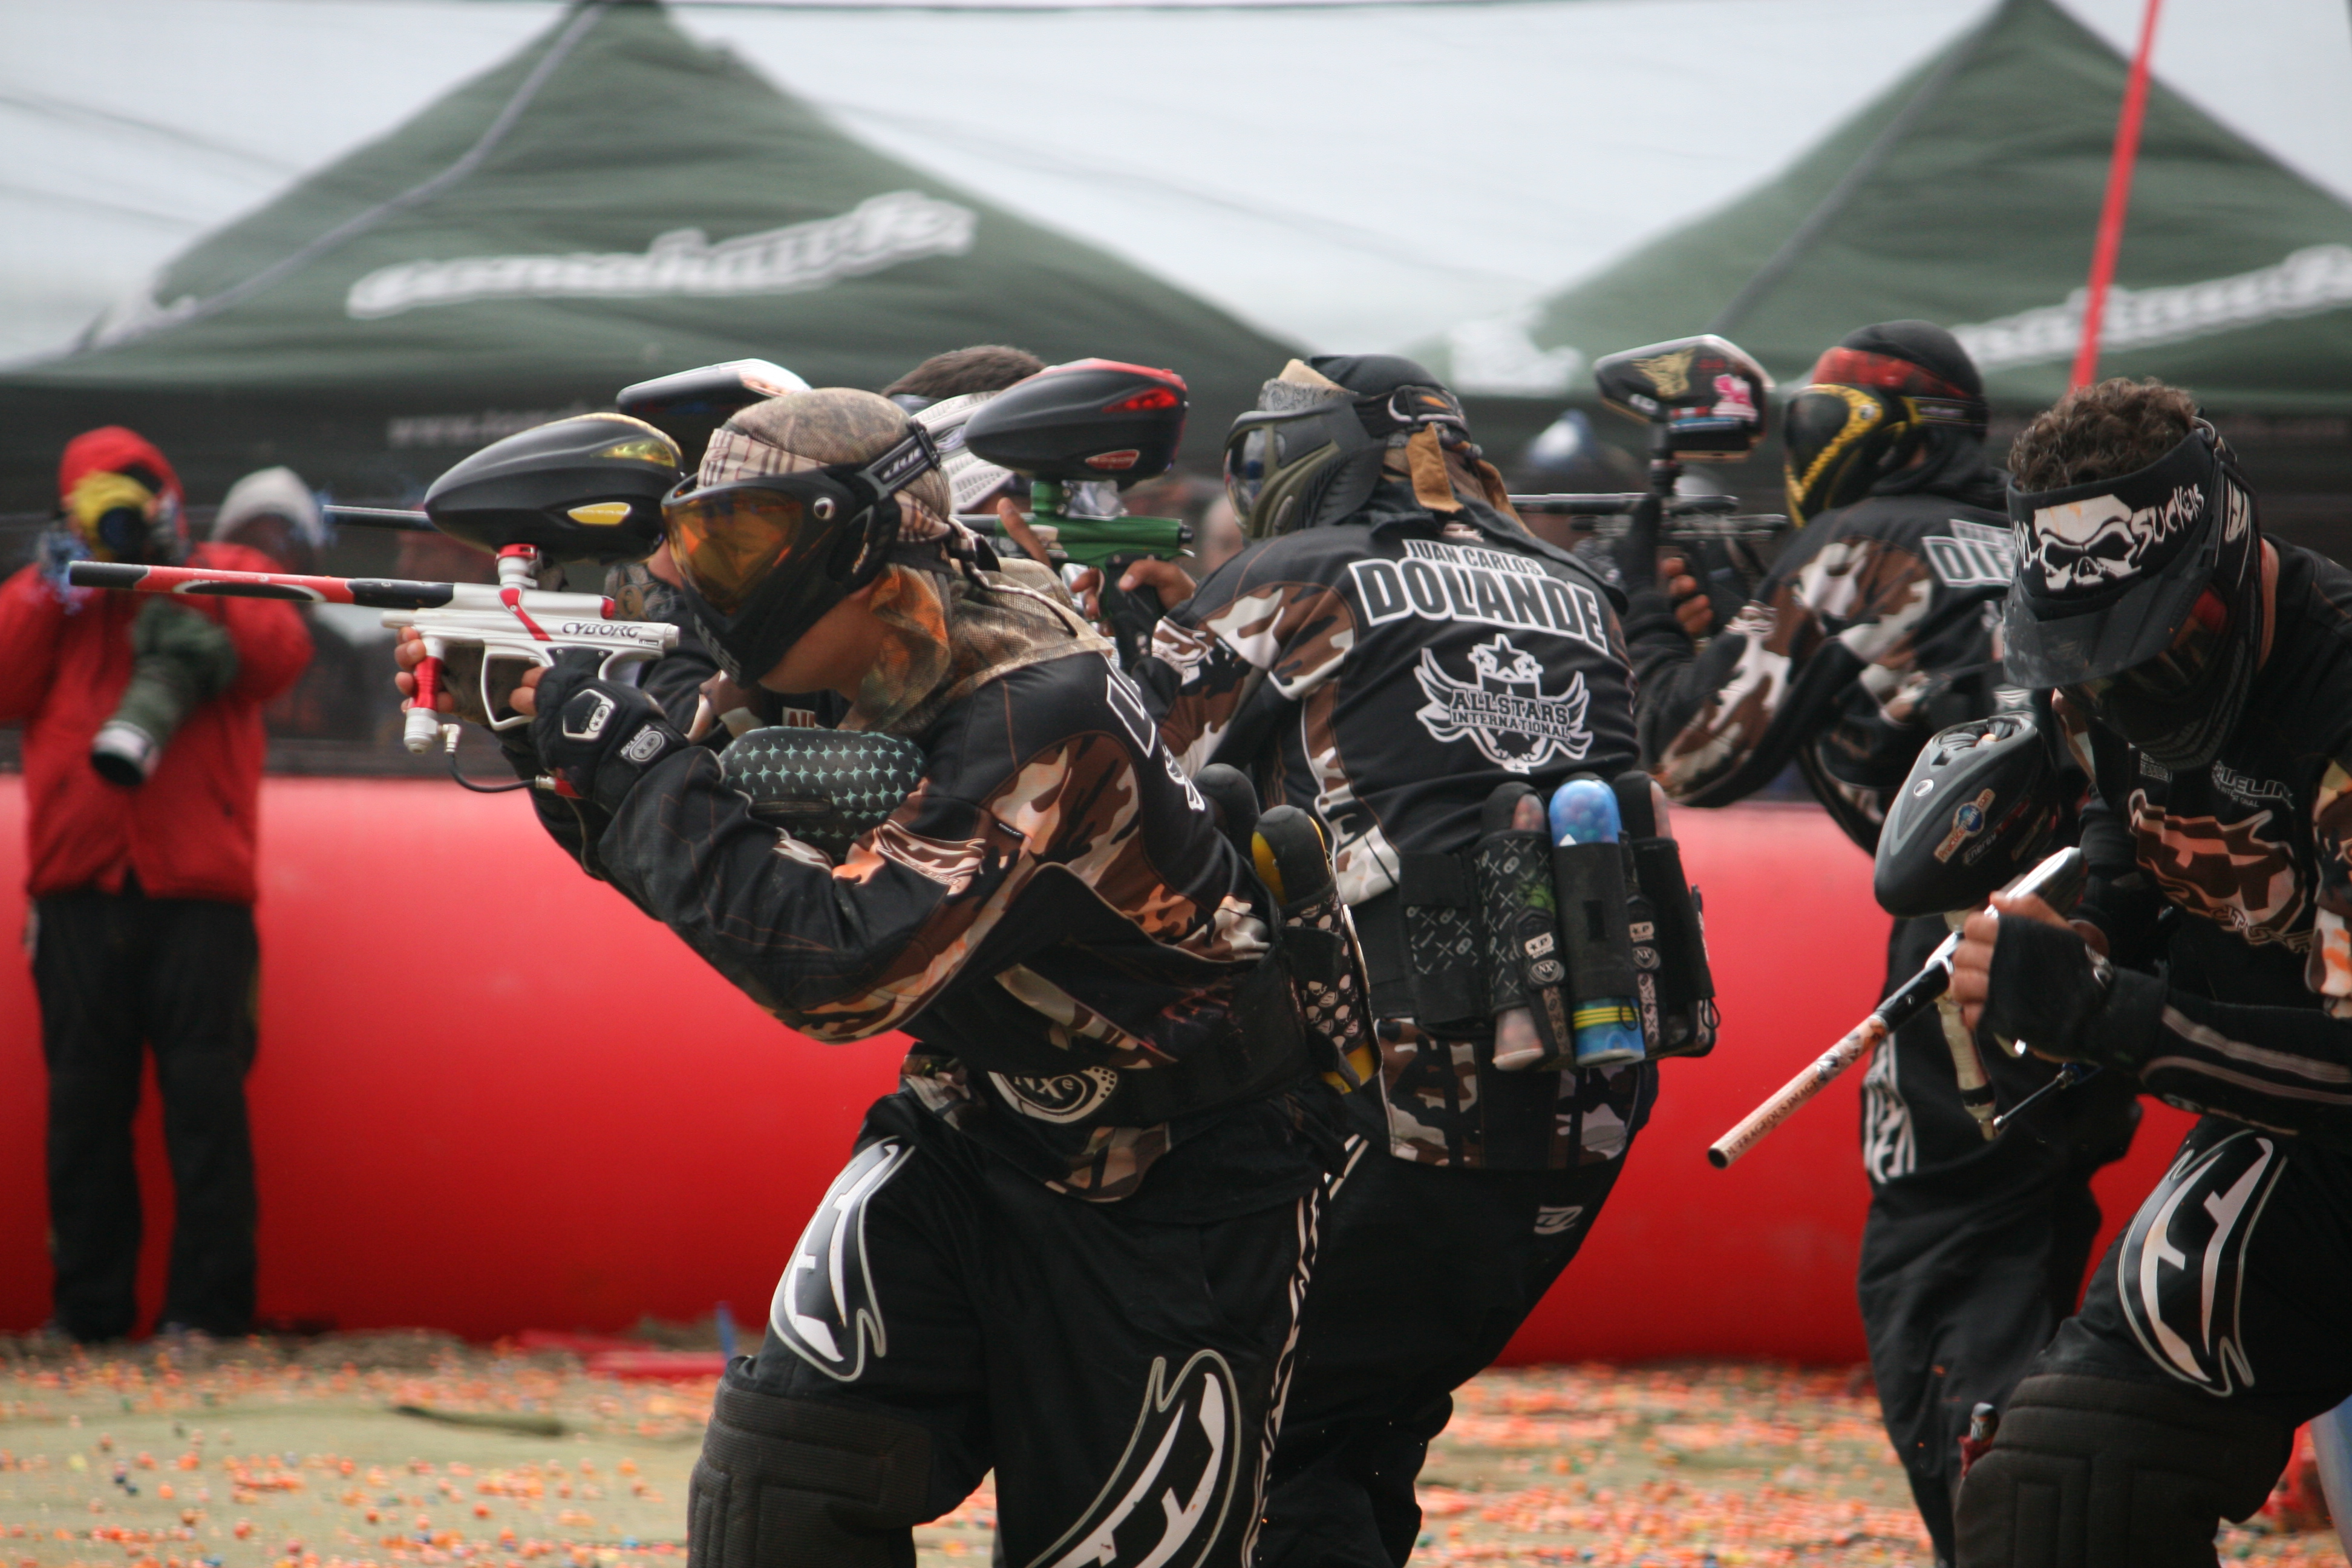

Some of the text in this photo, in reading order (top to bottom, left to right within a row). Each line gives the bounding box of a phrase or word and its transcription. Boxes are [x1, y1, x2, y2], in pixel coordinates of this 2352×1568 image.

[1404, 540, 1546, 576] JUAN CARLOS
[1348, 558, 1610, 655] DOLANDE
[561, 622, 642, 639] CYBORG
[1452, 691, 1568, 725] ALLSTARS
[1452, 711, 1569, 739] INTERNATIONAL
